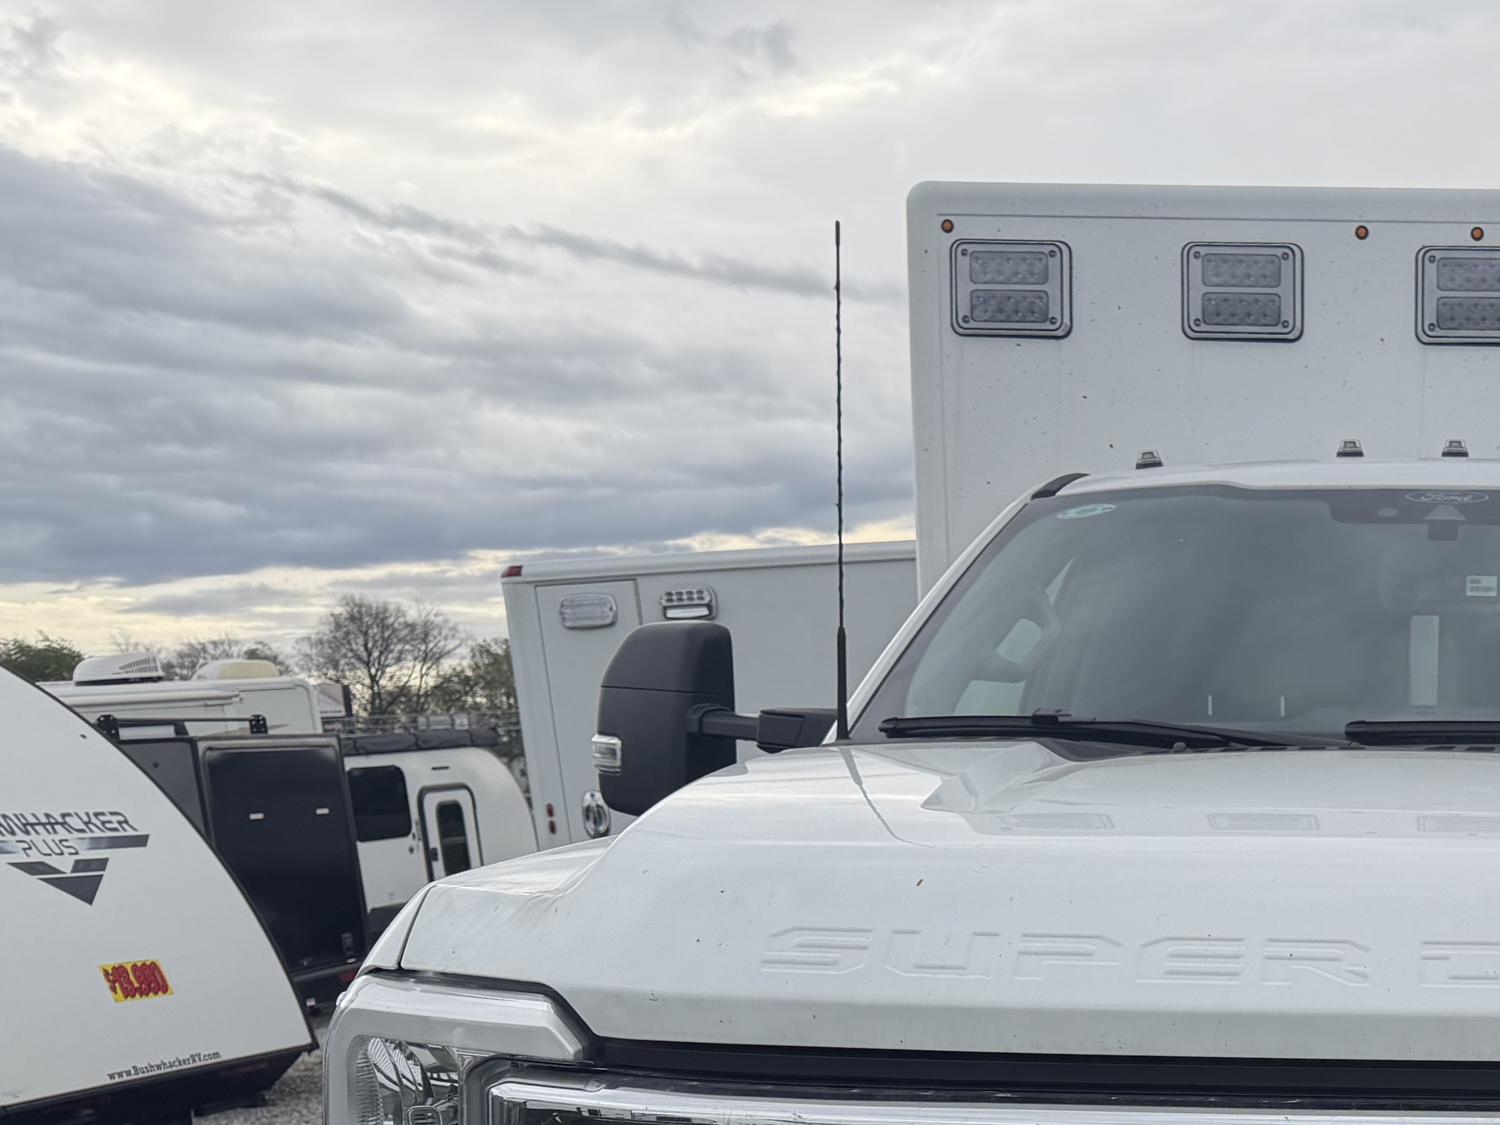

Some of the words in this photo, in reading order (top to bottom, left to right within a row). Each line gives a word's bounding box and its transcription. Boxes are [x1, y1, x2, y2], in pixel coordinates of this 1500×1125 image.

[0, 811, 139, 836] WHACKER
[16, 838, 79, 857] PLUS
[760, 926, 1373, 987] SUPER
